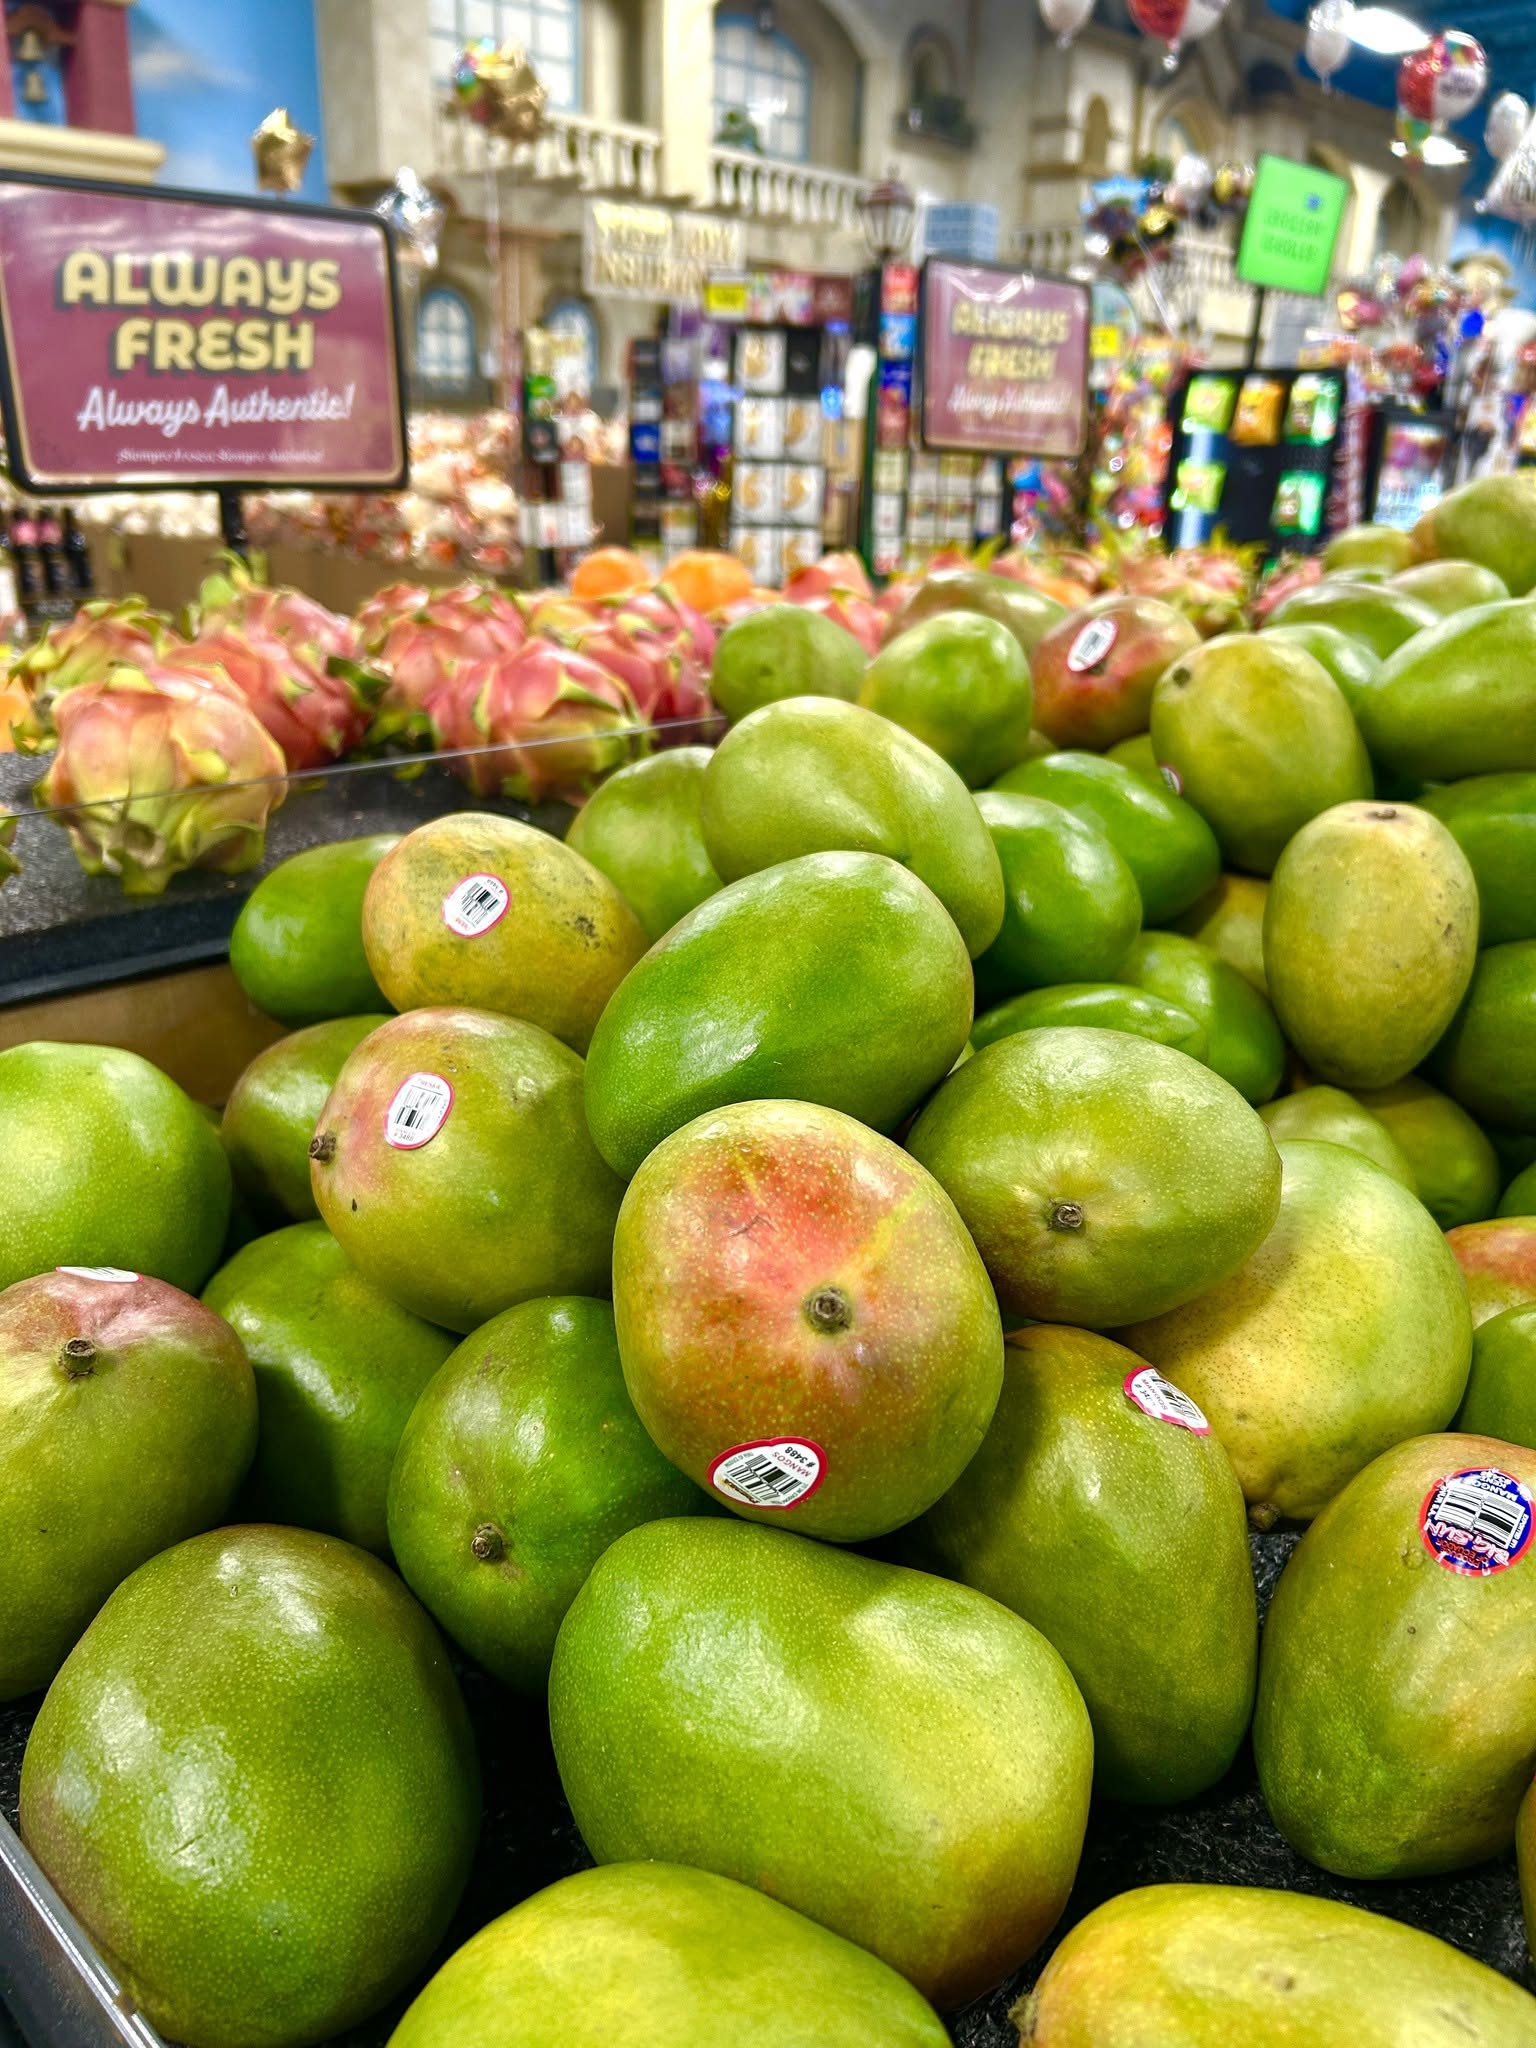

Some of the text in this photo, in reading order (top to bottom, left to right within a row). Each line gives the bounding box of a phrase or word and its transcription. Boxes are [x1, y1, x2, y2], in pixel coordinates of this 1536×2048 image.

[62, 250, 342, 315] ALWAYS
[114, 317, 315, 371] FRESH
[77, 383, 356, 438] Always Authentic!
[772, 1451, 812, 1477] MANGOS
[784, 1446, 808, 1464] 3488
[1423, 1518, 1510, 1567] BIG SUN
[1436, 1539, 1476, 1558] ECUADOR
